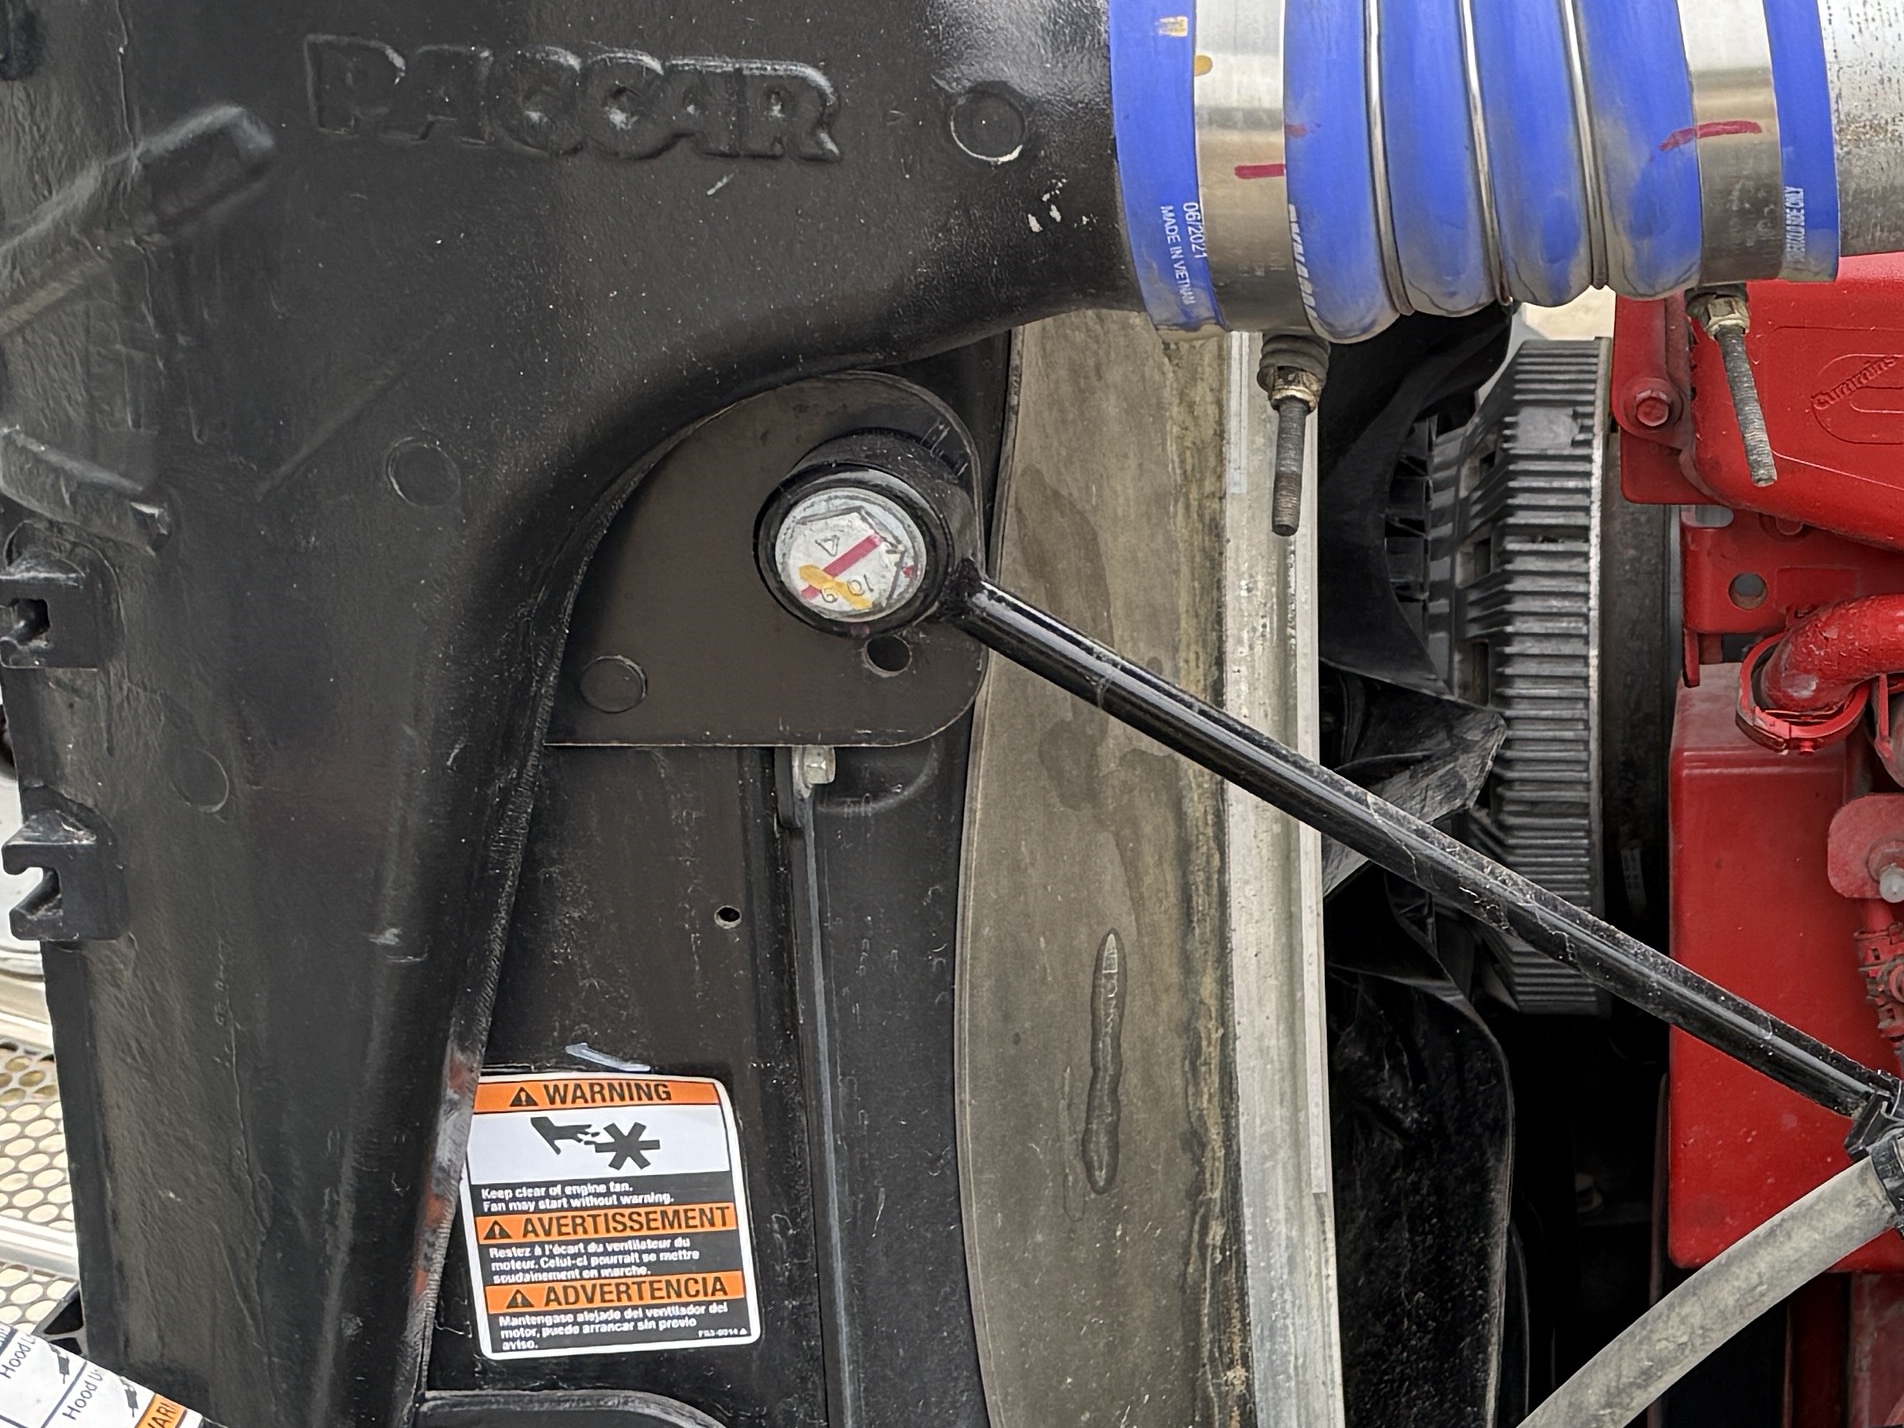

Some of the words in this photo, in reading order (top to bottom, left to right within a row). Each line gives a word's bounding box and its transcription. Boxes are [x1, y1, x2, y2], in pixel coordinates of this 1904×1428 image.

[303, 33, 841, 162] PACCAR
[1159, 204, 1181, 244] MADE
[1182, 200, 1207, 259] 06/2021
[1169, 245, 1184, 259] IN
[543, 1082, 673, 1106] WARNING
[481, 1187, 513, 1201] Keep
[515, 1186, 546, 1199] clear
[549, 1184, 563, 1196] of
[564, 1183, 607, 1197] engine
[609, 1181, 633, 1193] fan.
[483, 1199, 506, 1212] Fan
[508, 1200, 536, 1213] may
[539, 1196, 569, 1210] start
[570, 1194, 619, 1208] without
[620, 1191, 675, 1206] warning.
[522, 1205, 731, 1240] AVERTISSEMENT
[488, 1246, 532, 1259] Restez
[605, 1238, 671, 1252] ventilateur
[674, 1236, 691, 1249] du
[590, 1252, 640, 1267] pourrait
[659, 1249, 700, 1261] mettre
[492, 1268, 580, 1284] soudainement
[582, 1269, 599, 1279] en
[600, 1265, 652, 1278] marche.
[543, 1275, 729, 1309] ADVERTENCIA
[576, 1310, 622, 1325] alejado
[623, 1307, 643, 1319] del
[645, 1304, 706, 1318] ventilador
[708, 1302, 728, 1314] del
[500, 1327, 540, 1341] motor,
[542, 1325, 580, 1339] puede
[582, 1322, 635, 1335] arrancar
[637, 1320, 657, 1331] sin
[658, 1317, 697, 1332] previo
[502, 1338, 539, 1352] aviso.
[0, 1336, 32, 1379] Hood
[62, 1379, 98, 1421] Hood
